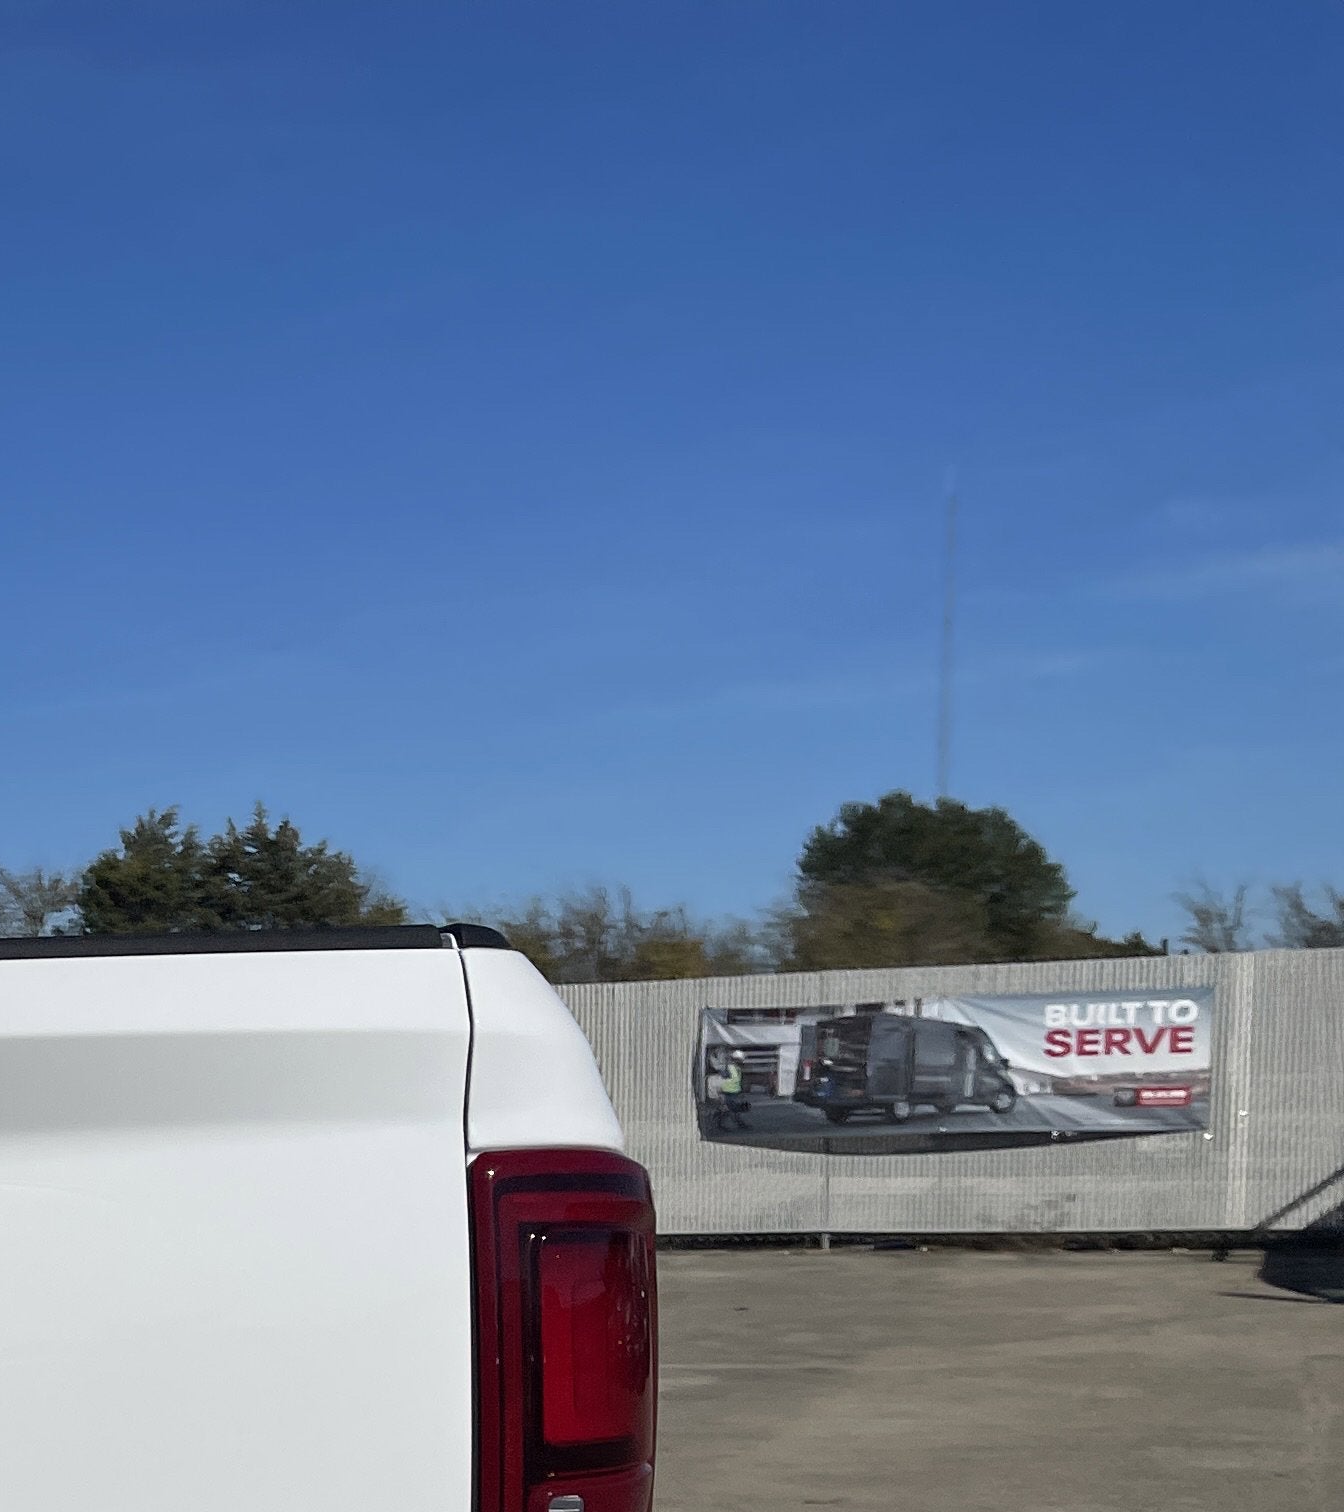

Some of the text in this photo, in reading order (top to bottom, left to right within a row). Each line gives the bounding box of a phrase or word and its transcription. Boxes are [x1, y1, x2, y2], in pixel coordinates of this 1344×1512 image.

[1044, 999, 1199, 1026] BUILT TO
[1043, 1026, 1194, 1057] SERVE
